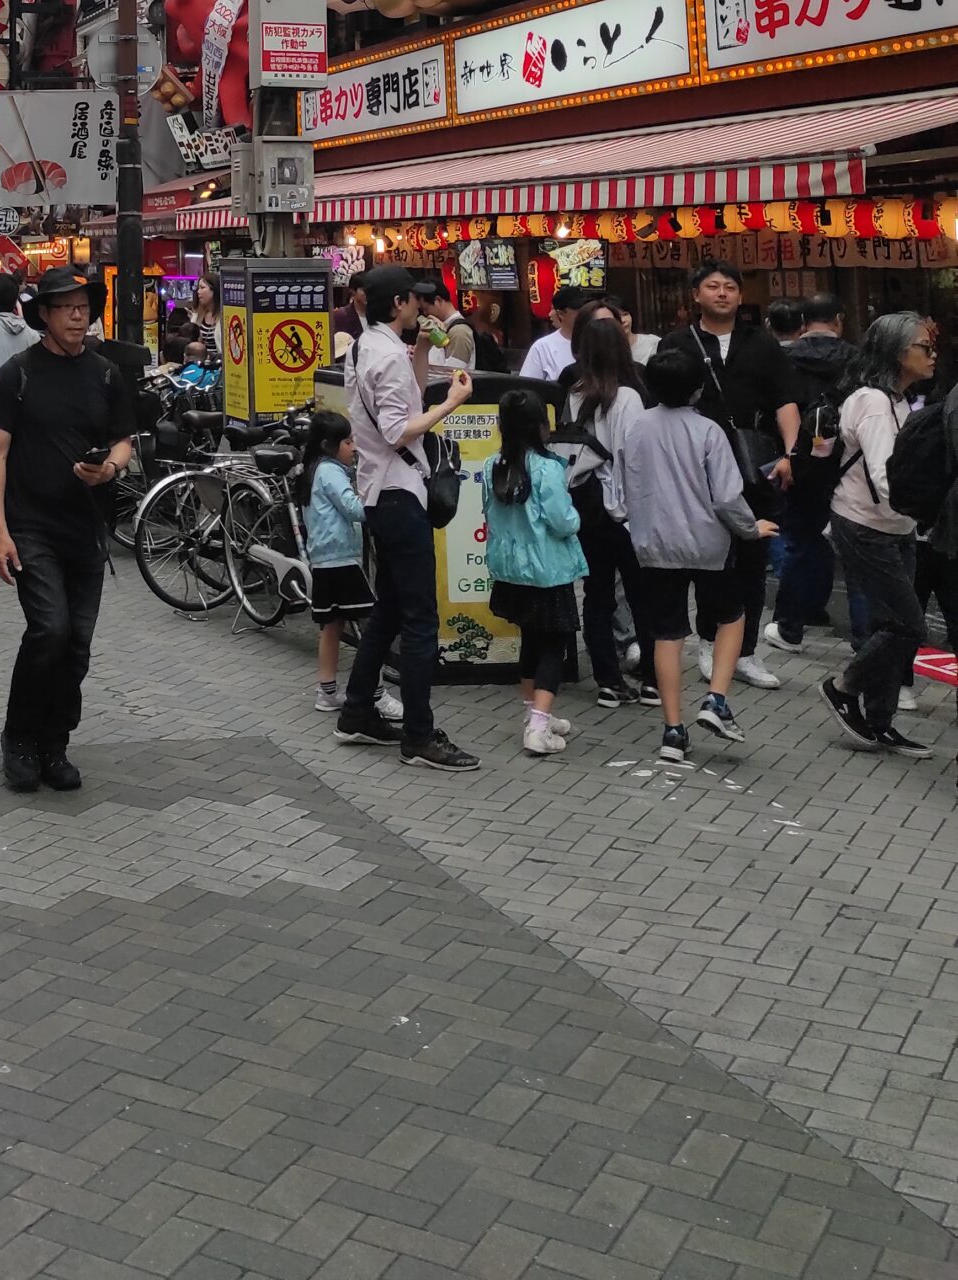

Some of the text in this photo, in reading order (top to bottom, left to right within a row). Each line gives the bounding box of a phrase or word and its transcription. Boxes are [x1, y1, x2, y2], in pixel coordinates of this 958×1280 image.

[215, 3, 236, 24] 2025
[209, 19, 229, 40] 大阪
[264, 25, 323, 39] 防犯監視カメラ
[281, 39, 308, 51] 作動中
[319, 66, 420, 127] 串カツ専門店
[69, 102, 90, 159] 居酒屋
